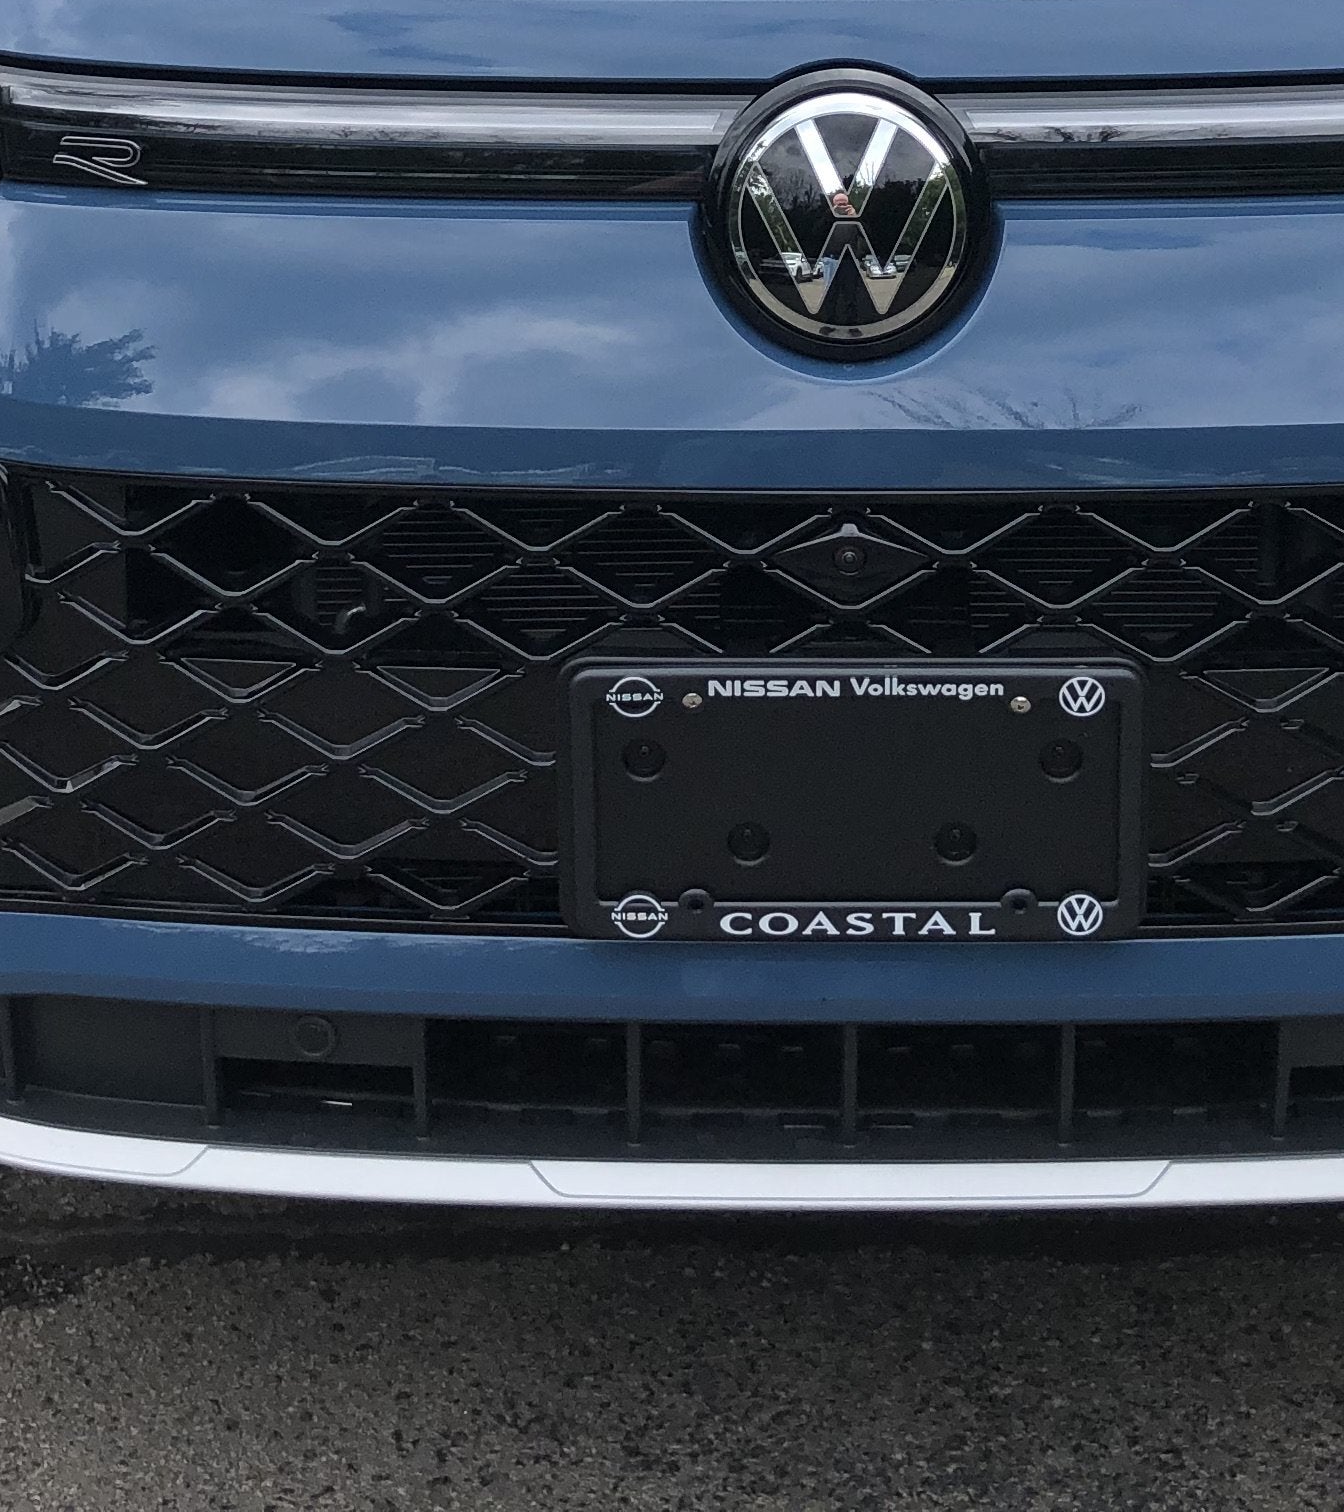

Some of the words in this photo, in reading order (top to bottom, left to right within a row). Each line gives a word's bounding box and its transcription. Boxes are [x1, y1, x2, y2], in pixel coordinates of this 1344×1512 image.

[52, 135, 149, 186] R
[736, 103, 960, 330] VW
[605, 691, 665, 704] NISSAN
[707, 679, 841, 698] NISSAN
[849, 676, 1005, 701] Volkswagen
[610, 909, 669, 922] NISSAN
[718, 910, 997, 937] COASTAL
